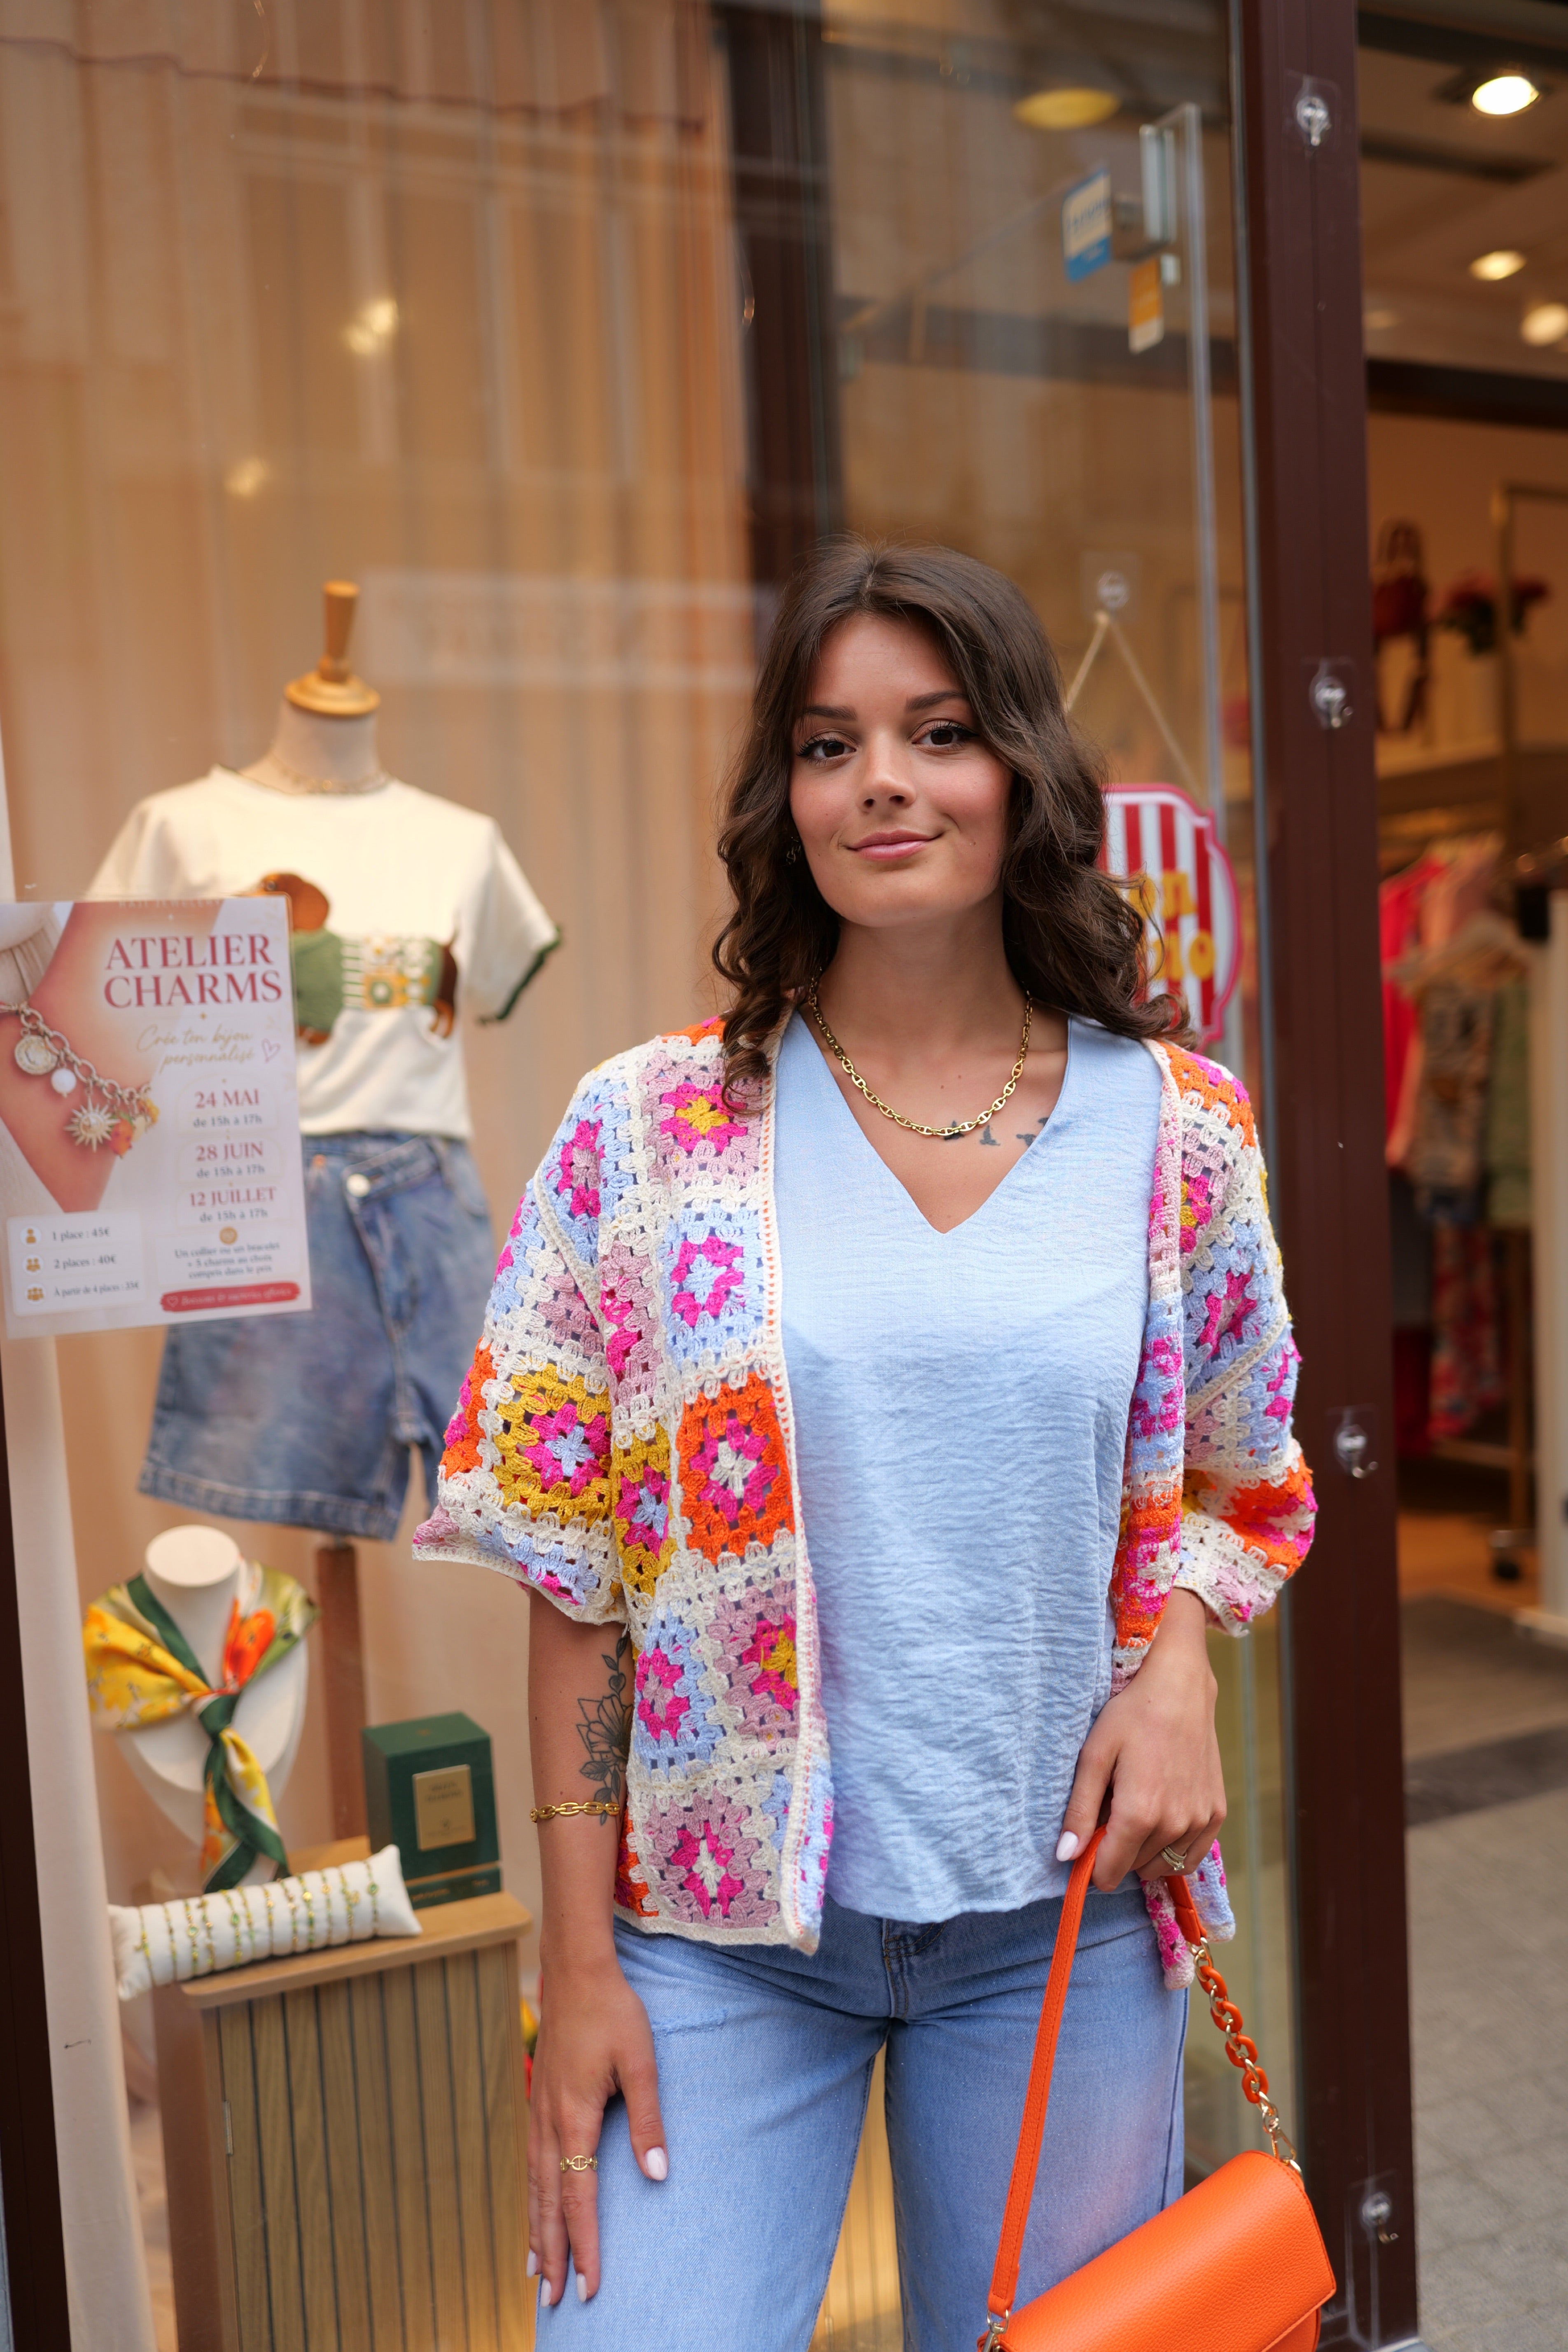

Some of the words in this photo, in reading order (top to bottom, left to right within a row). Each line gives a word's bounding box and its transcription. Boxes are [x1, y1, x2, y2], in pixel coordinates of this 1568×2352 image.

[105, 933, 274, 970] ATELIER
[104, 969, 282, 1009] CHARMS
[182, 1028, 205, 1045] ton
[212, 1023, 253, 1051] bijou
[159, 1044, 255, 1074] personnalisé
[194, 1091, 216, 1109] 24
[223, 1088, 259, 1107] MAI
[193, 1116, 207, 1128] de
[210, 1115, 230, 1127] 15h
[233, 1115, 240, 1125] à
[243, 1114, 262, 1124] 17h
[196, 1144, 218, 1161] 28
[223, 1141, 264, 1161] JUIN
[196, 1167, 210, 1178] de
[214, 1165, 233, 1177] 15h
[236, 1165, 243, 1175] à
[247, 1163, 265, 1174] 17h
[190, 1191, 205, 1206] 12
[210, 1186, 277, 1208] JUILLET
[199, 1212, 213, 1223] de
[217, 1210, 236, 1221] 15h
[240, 1210, 246, 1220] à
[250, 1208, 268, 1219] 17h
[52, 1231, 57, 1241] 1
[61, 1230, 84, 1243] place
[92, 1227, 110, 1237] 45€
[175, 1248, 188, 1258] Un
[191, 1246, 217, 1256] collier
[247, 1242, 280, 1251] bracelet
[54, 1259, 60, 1269] 2
[63, 1257, 90, 1270] places
[98, 1254, 117, 1264] 40€
[204, 1257, 235, 1268] charms
[189, 1269, 223, 1279] compris
[62, 1286, 81, 1298] partir
[83, 1285, 91, 1294] de
[93, 1285, 98, 1293] 4
[99, 1282, 120, 1295] places
[125, 1280, 140, 1290] 35€
